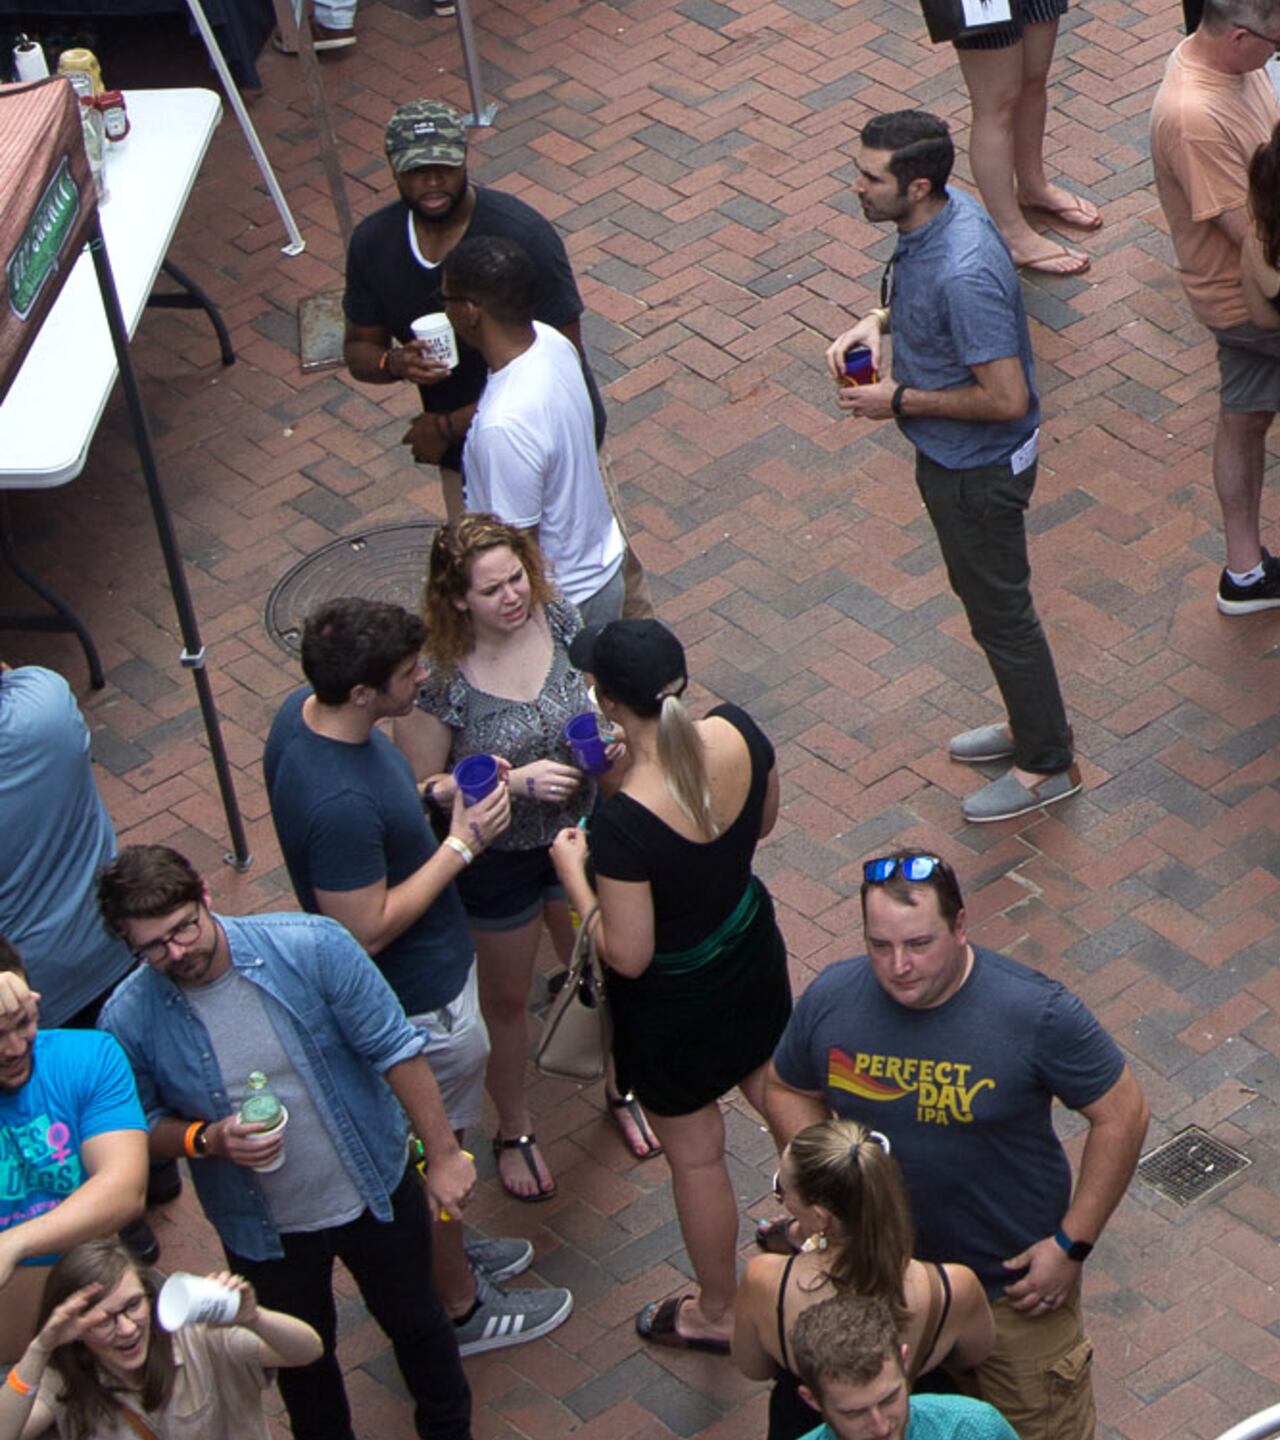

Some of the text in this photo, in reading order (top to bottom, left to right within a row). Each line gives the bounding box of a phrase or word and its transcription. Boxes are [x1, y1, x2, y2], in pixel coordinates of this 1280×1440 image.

[855, 1053, 973, 1092] PERFECT
[917, 1078, 996, 1123] DAY
[917, 1108, 949, 1126] IPA
